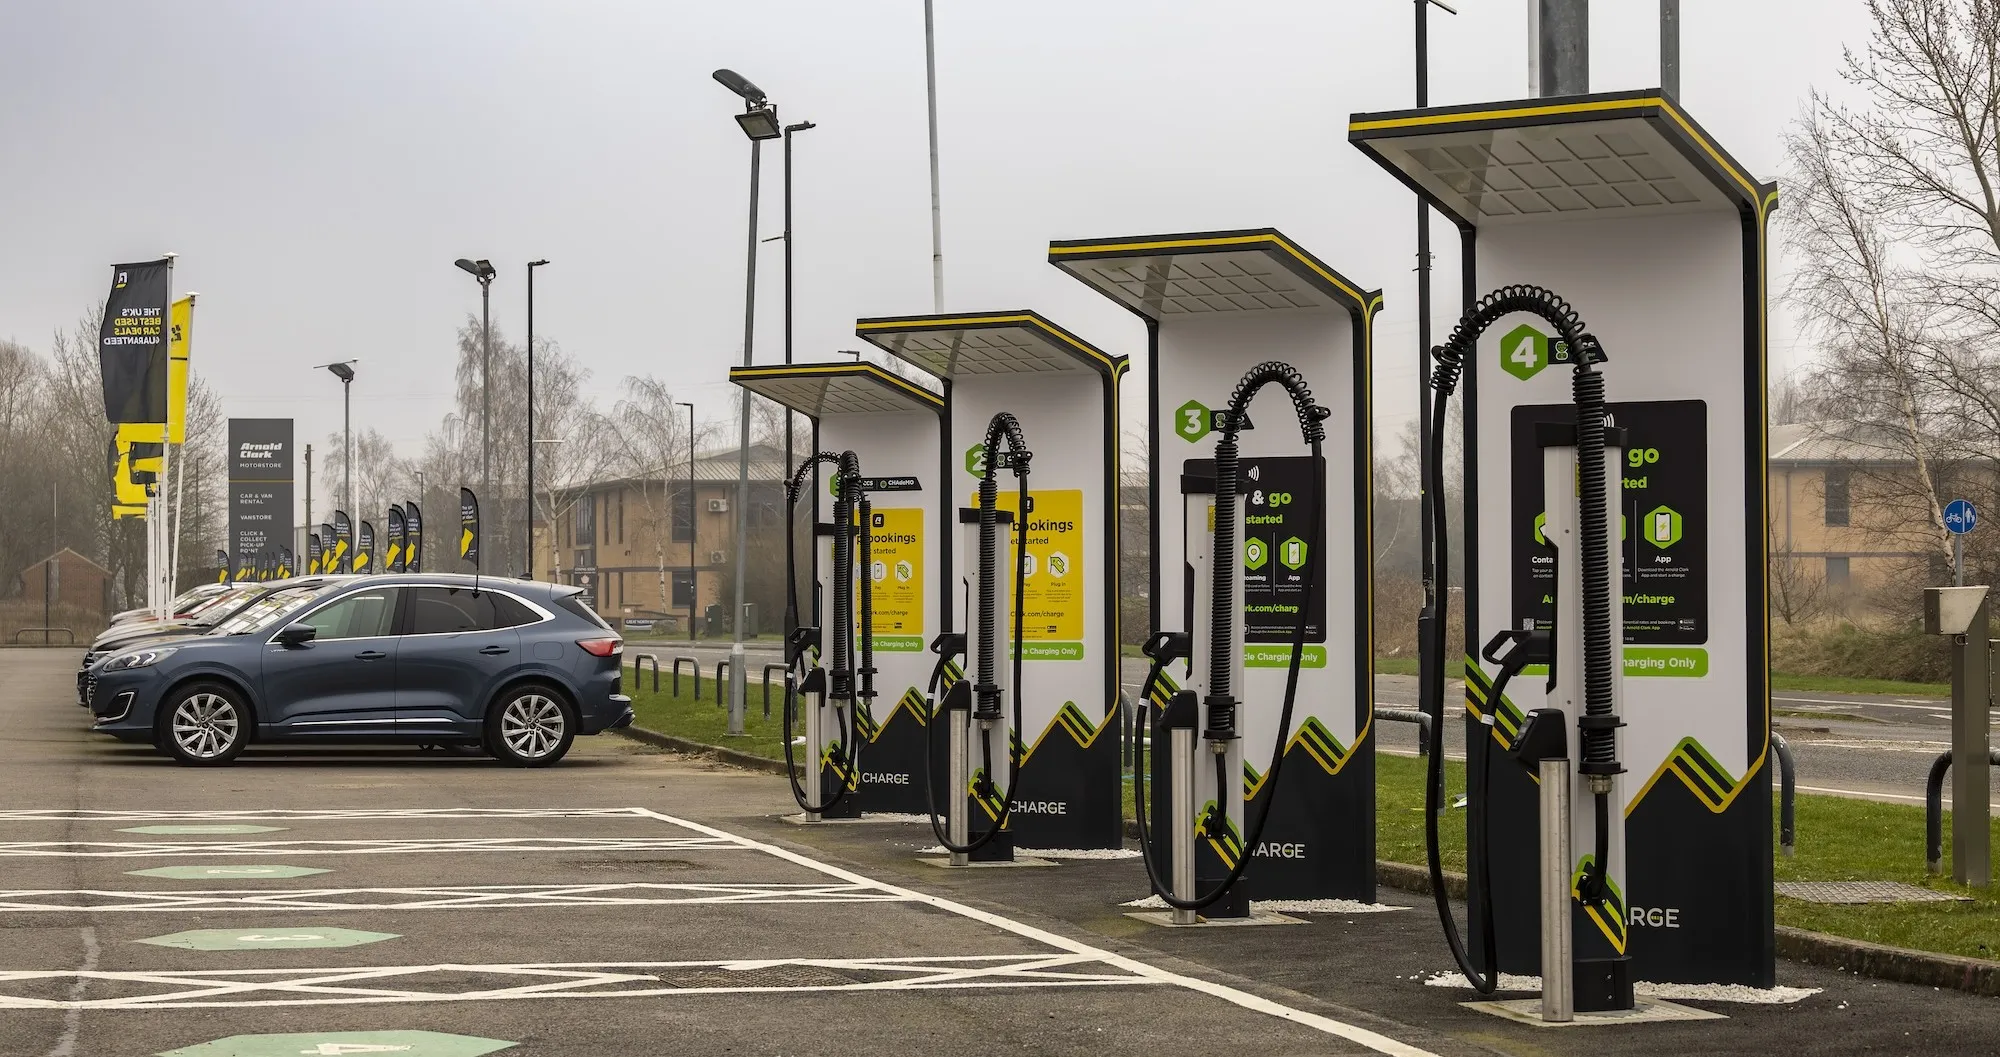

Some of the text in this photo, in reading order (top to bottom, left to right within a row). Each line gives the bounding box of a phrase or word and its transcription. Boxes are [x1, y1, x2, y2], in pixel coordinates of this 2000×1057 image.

[1510, 336, 1538, 368] 4
[1183, 409, 1202, 435] 3
[240, 442, 283, 451] Arnold
[240, 450, 273, 459] Clark
[1628, 448, 1660, 468] go
[972, 451, 987, 471] 2
[1252, 489, 1265, 505] &
[1268, 492, 1292, 508] go
[1246, 514, 1283, 524] started
[1024, 537, 1049, 545] tarted
[873, 547, 896, 555] started
[1531, 556, 1554, 564] Conta
[1655, 555, 1672, 564] App
[1029, 647, 1060, 656] Charging
[1061, 647, 1078, 656] Only
[1623, 657, 1697, 669] harging Only
[861, 772, 910, 785] CHARGE
[1009, 800, 1067, 815] CHARGE
[1252, 841, 1306, 859] ARGE
[1625, 906, 1680, 929] RGE
